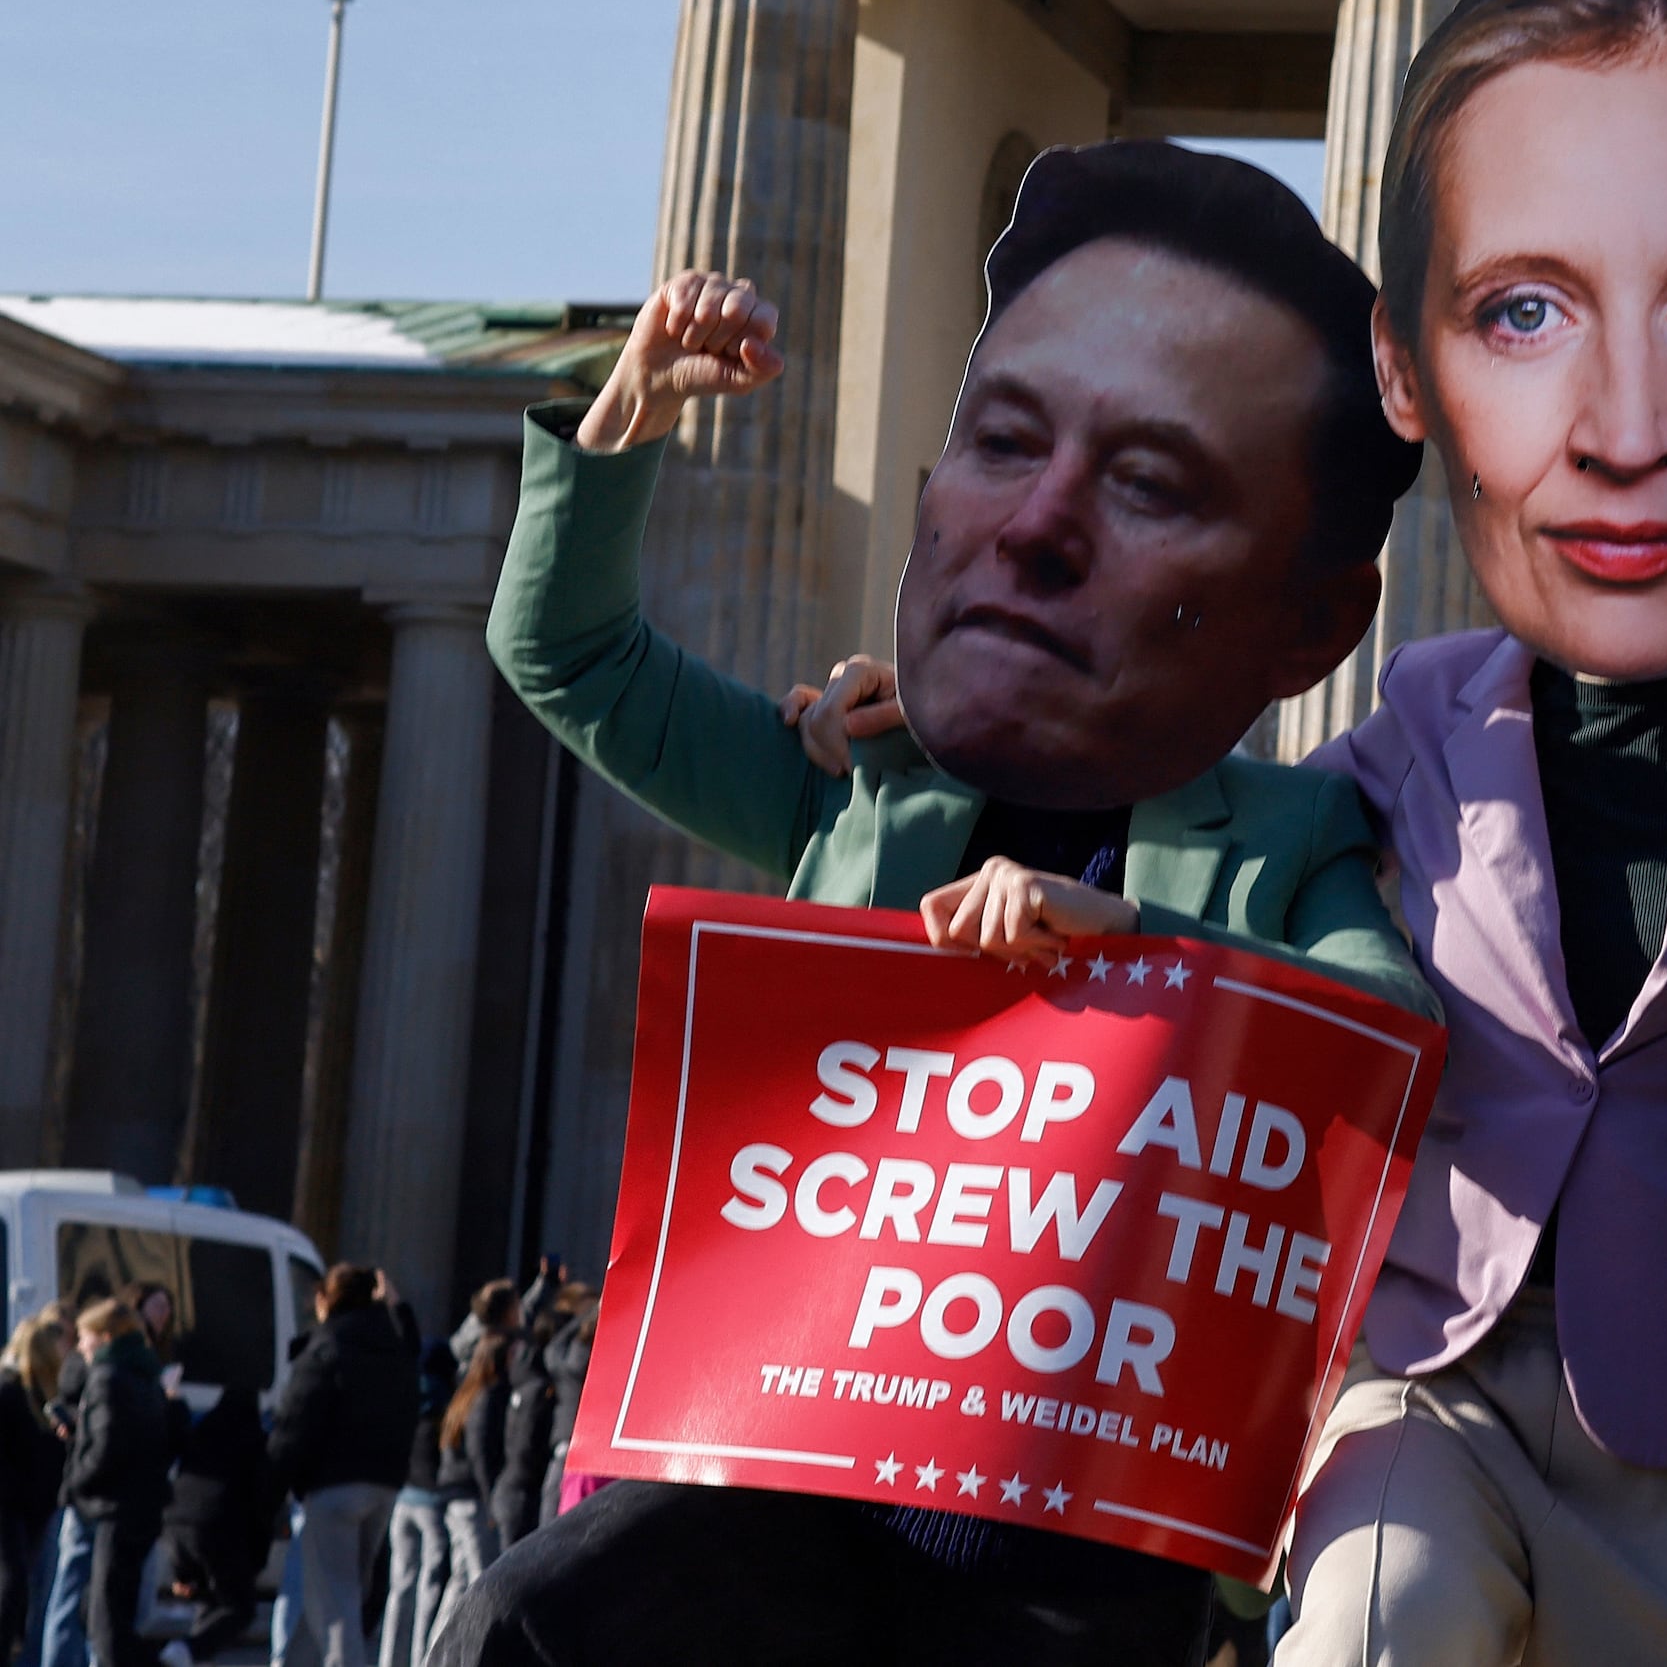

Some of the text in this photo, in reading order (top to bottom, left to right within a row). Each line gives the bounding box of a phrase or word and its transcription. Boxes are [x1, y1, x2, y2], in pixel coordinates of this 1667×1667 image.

[810, 1042, 1305, 1188] STOP AID
[721, 1144, 1331, 1322] SCREW THE
[848, 1266, 1175, 1396] POOR
[761, 1364, 1228, 1469] THE TRUMP & WEIDEL PLAN
